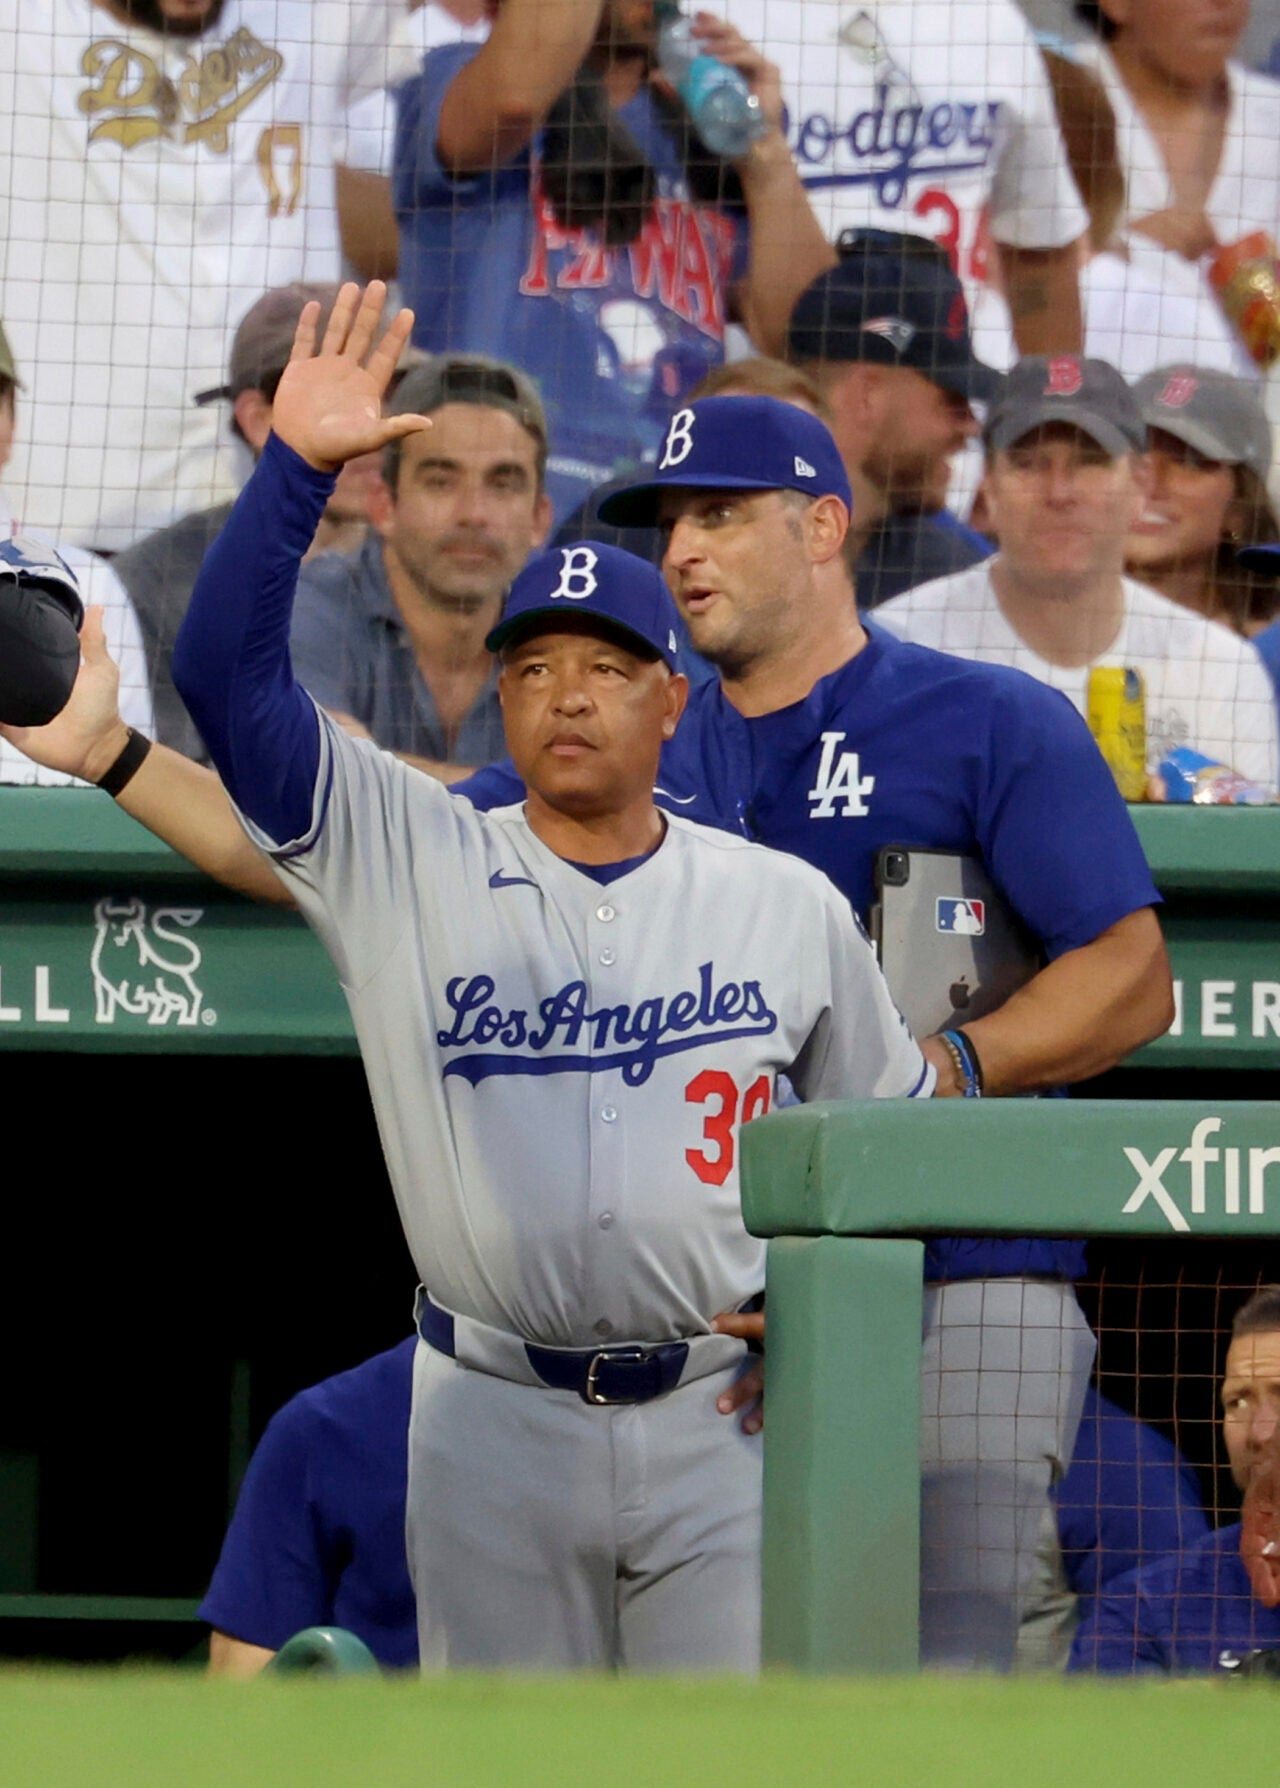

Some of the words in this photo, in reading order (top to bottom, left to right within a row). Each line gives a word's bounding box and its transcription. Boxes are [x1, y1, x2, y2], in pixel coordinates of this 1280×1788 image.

[659, 409, 696, 470] B
[550, 547, 599, 600] B
[808, 732, 875, 818] LA
[437, 975, 528, 1048] Los
[529, 961, 776, 1087] Angeles
